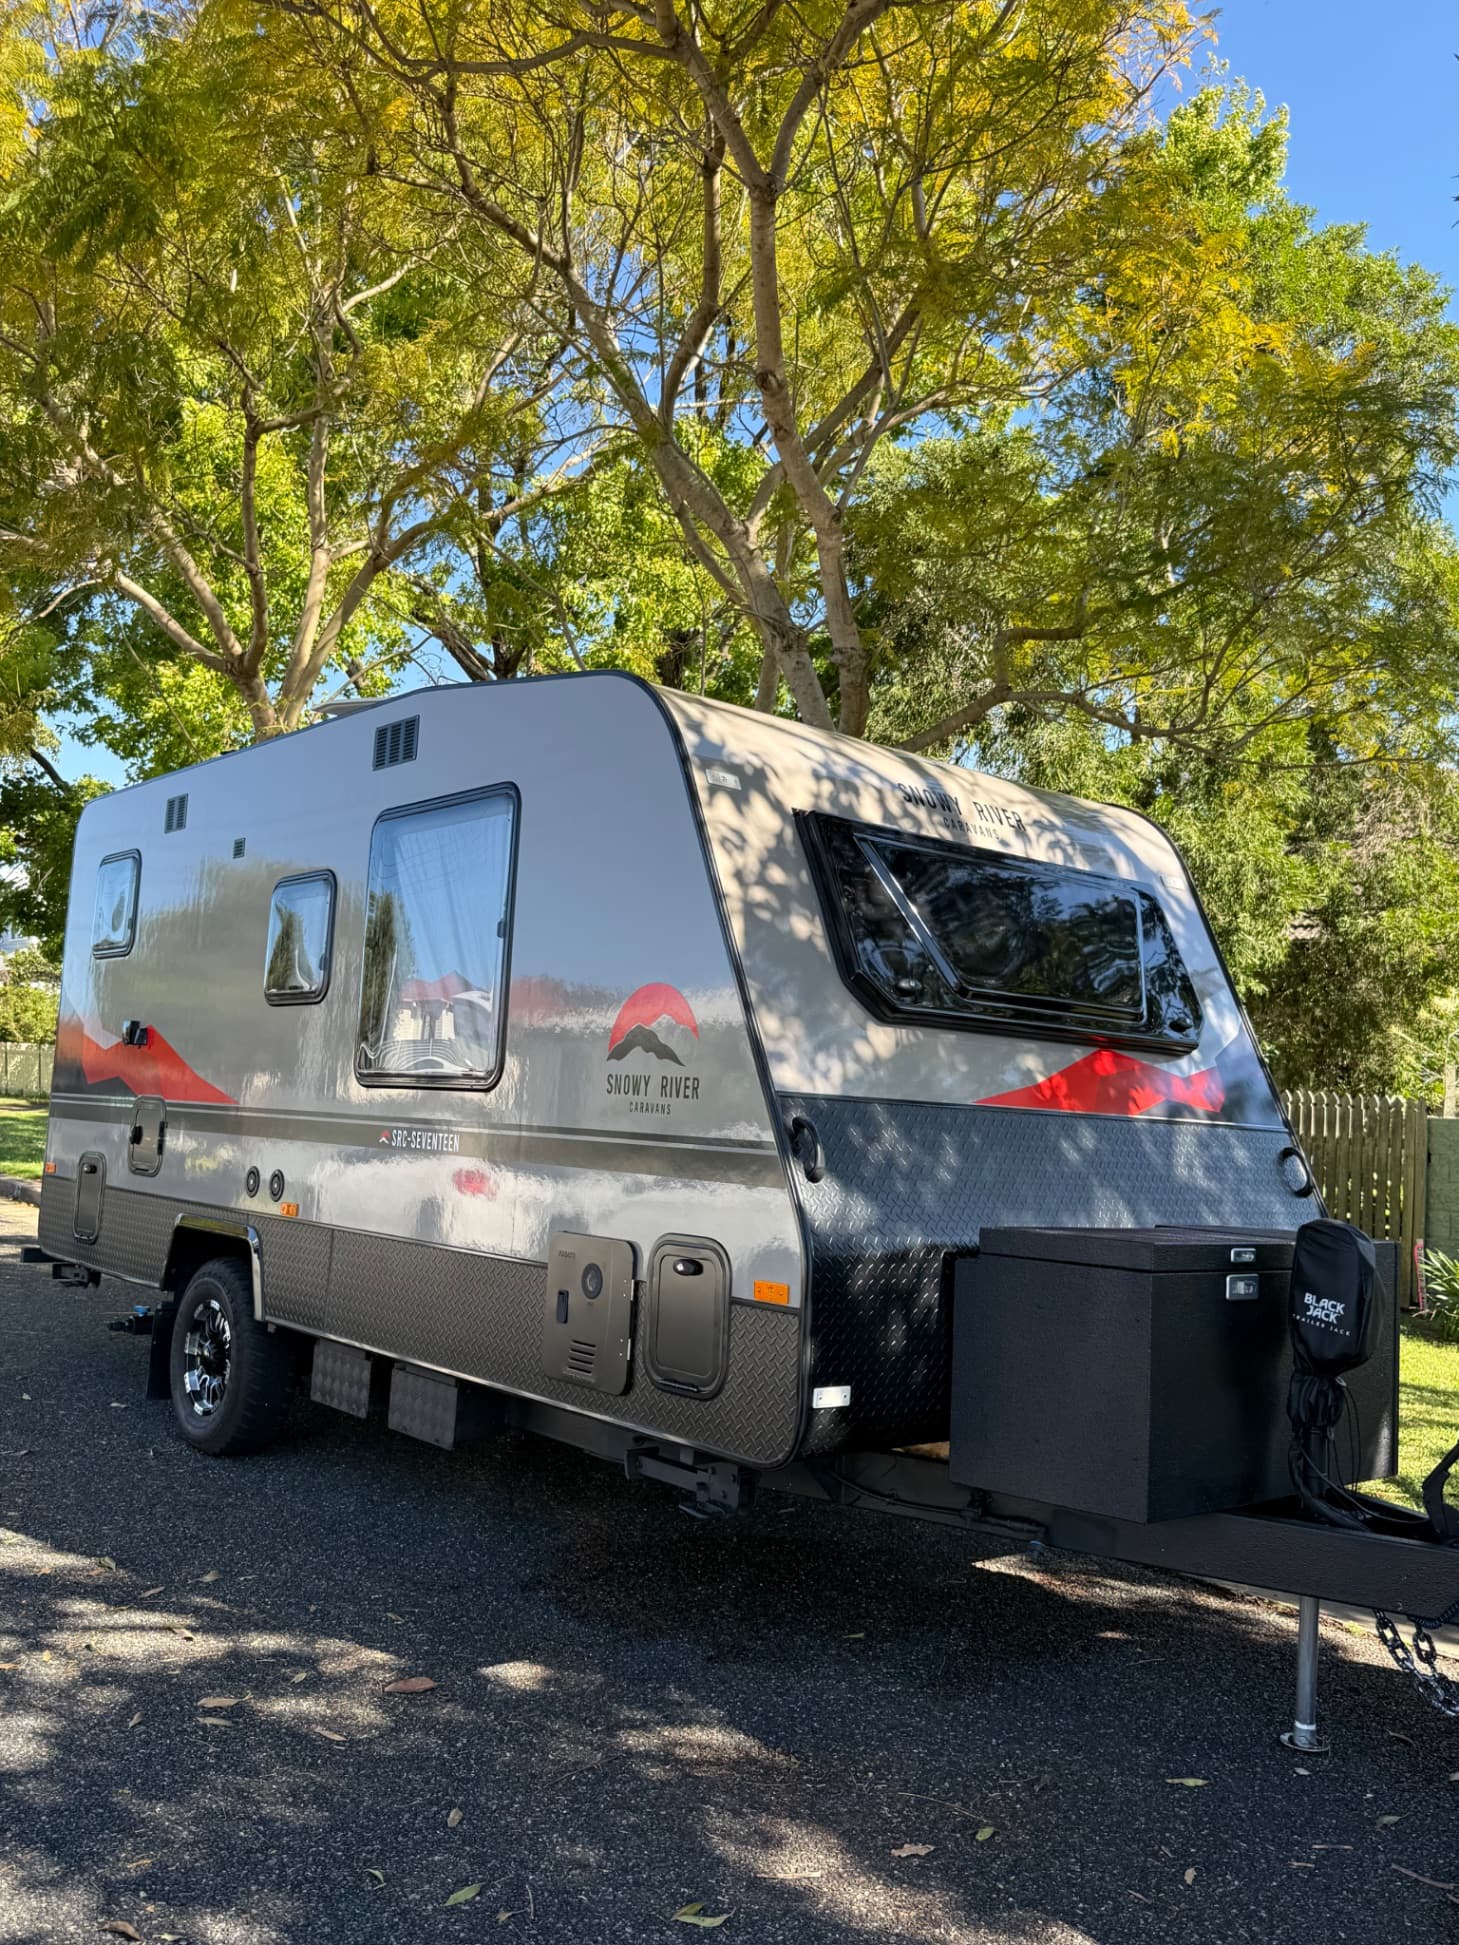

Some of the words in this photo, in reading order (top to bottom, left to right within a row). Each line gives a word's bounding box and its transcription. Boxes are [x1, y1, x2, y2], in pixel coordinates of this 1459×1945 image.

[898, 782, 962, 816] SNOWY
[972, 801, 1026, 832] RIVER
[943, 816, 1000, 841] CARAVANS
[606, 1073, 651, 1097] SNOWY
[660, 1075, 700, 1100] RIVER
[629, 1101, 672, 1116] CARAVANS
[391, 1129, 460, 1153] SRC-SEVENTEEN
[1304, 1292, 1346, 1315] BLACK
[1306, 1305, 1338, 1324] JACK
[1329, 1325, 1351, 1337] JACK
